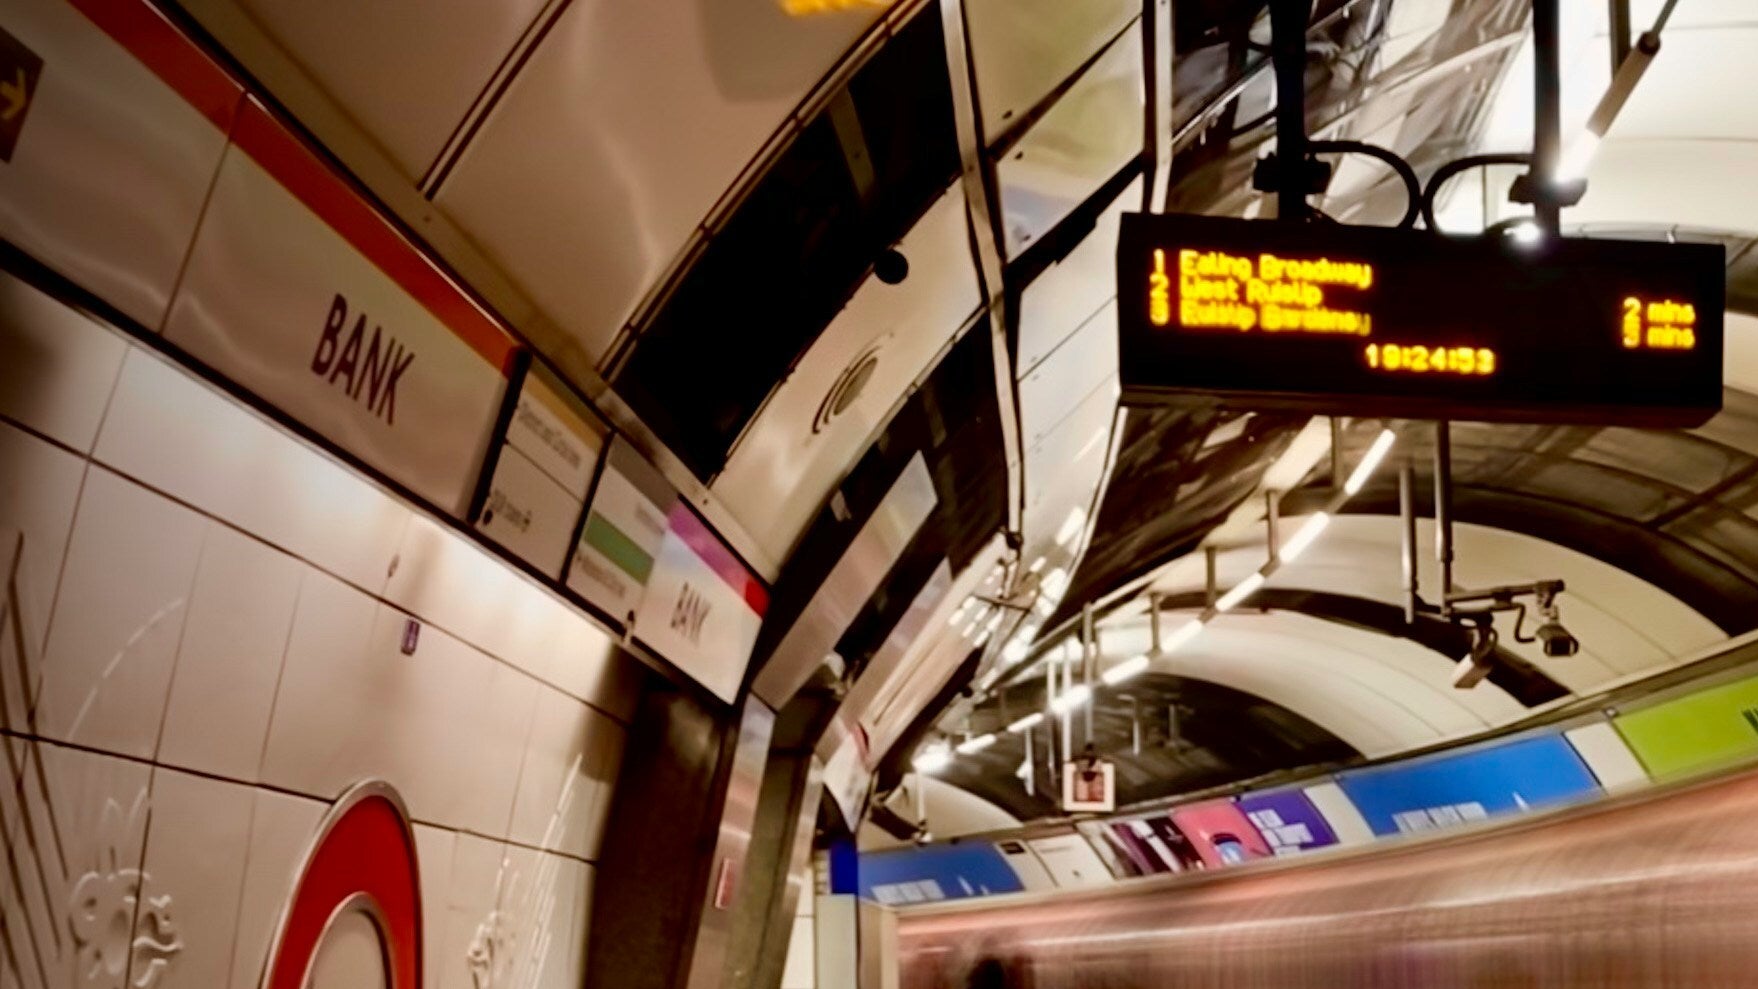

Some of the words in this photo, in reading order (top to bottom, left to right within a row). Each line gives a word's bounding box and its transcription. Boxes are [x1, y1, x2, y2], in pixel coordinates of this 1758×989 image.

[1153, 249, 1165, 273] 1
[1179, 249, 1253, 281] Ealing
[1258, 254, 1373, 290] Broadway
[1150, 273, 1169, 301] 2
[1179, 276, 1240, 302] West
[1623, 297, 1641, 323] 2
[1647, 300, 1695, 324] mins
[311, 293, 415, 426] BANK
[1647, 325, 1695, 349] mins
[671, 582, 711, 648] BANK
